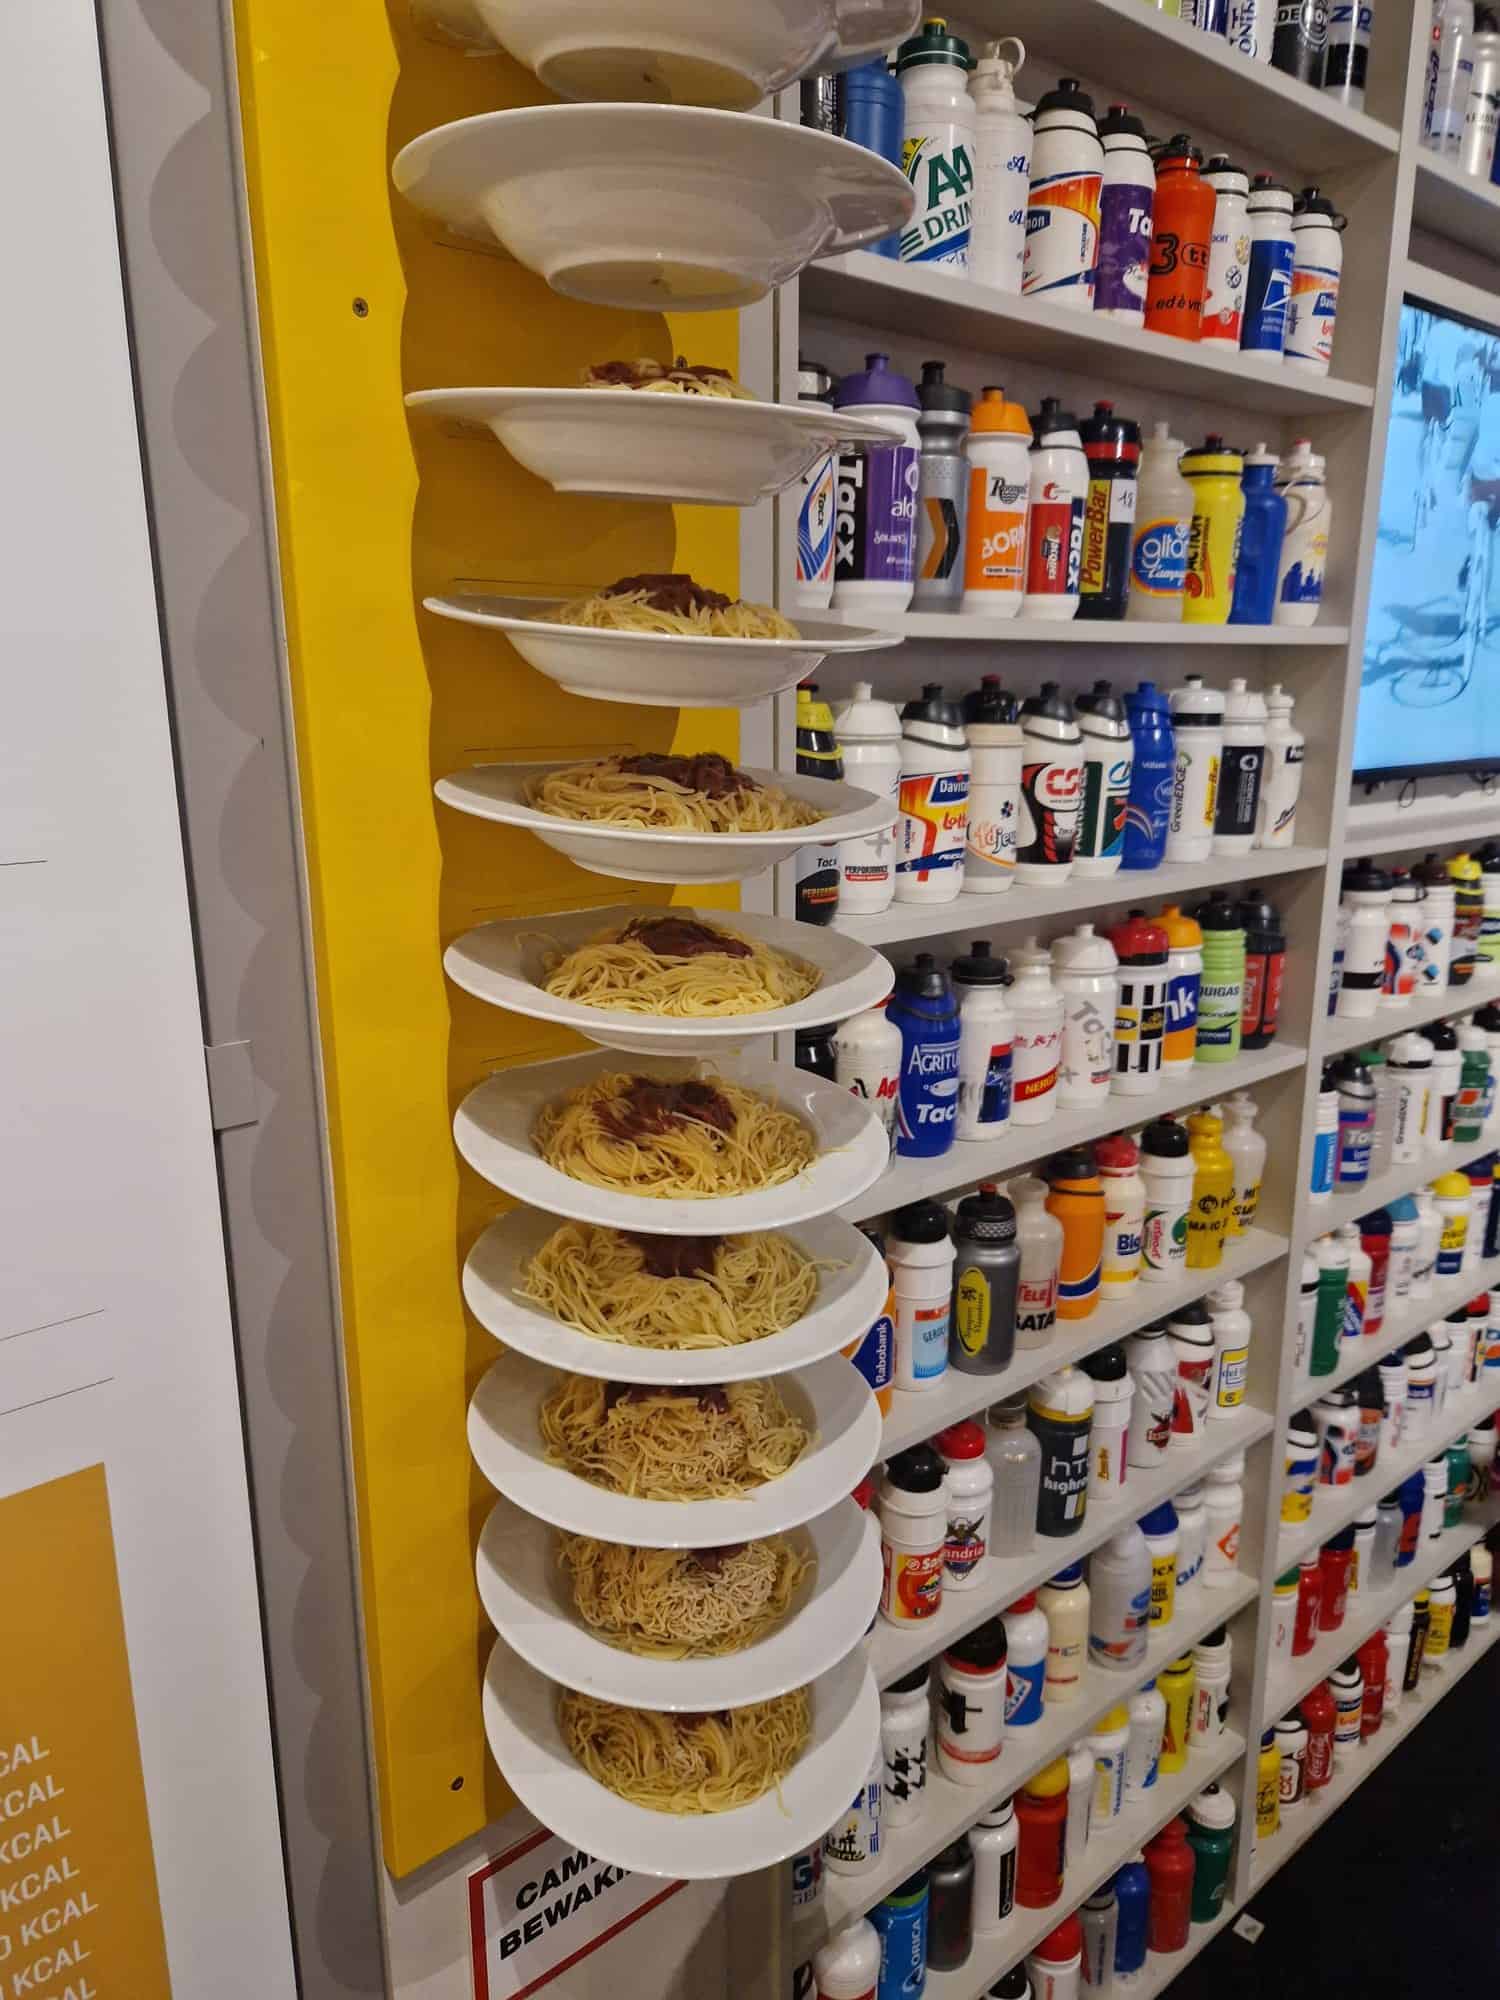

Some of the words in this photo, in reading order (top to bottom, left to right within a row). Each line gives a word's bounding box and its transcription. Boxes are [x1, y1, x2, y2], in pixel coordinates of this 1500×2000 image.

[836, 459, 864, 568] Tacx
[1081, 486, 1107, 587] PowerBar
[1067, 516, 1084, 588] Tacx
[1171, 766, 1187, 832] GreenEDGE
[875, 1321, 889, 1384] Rabobank
[0, 1856, 80, 1913] KCAL
[515, 1850, 600, 1912] CAM
[21, 1891, 98, 1946] KCAL
[911, 1918, 921, 1965] ORICA
[13, 1939, 91, 1996] KCAL
